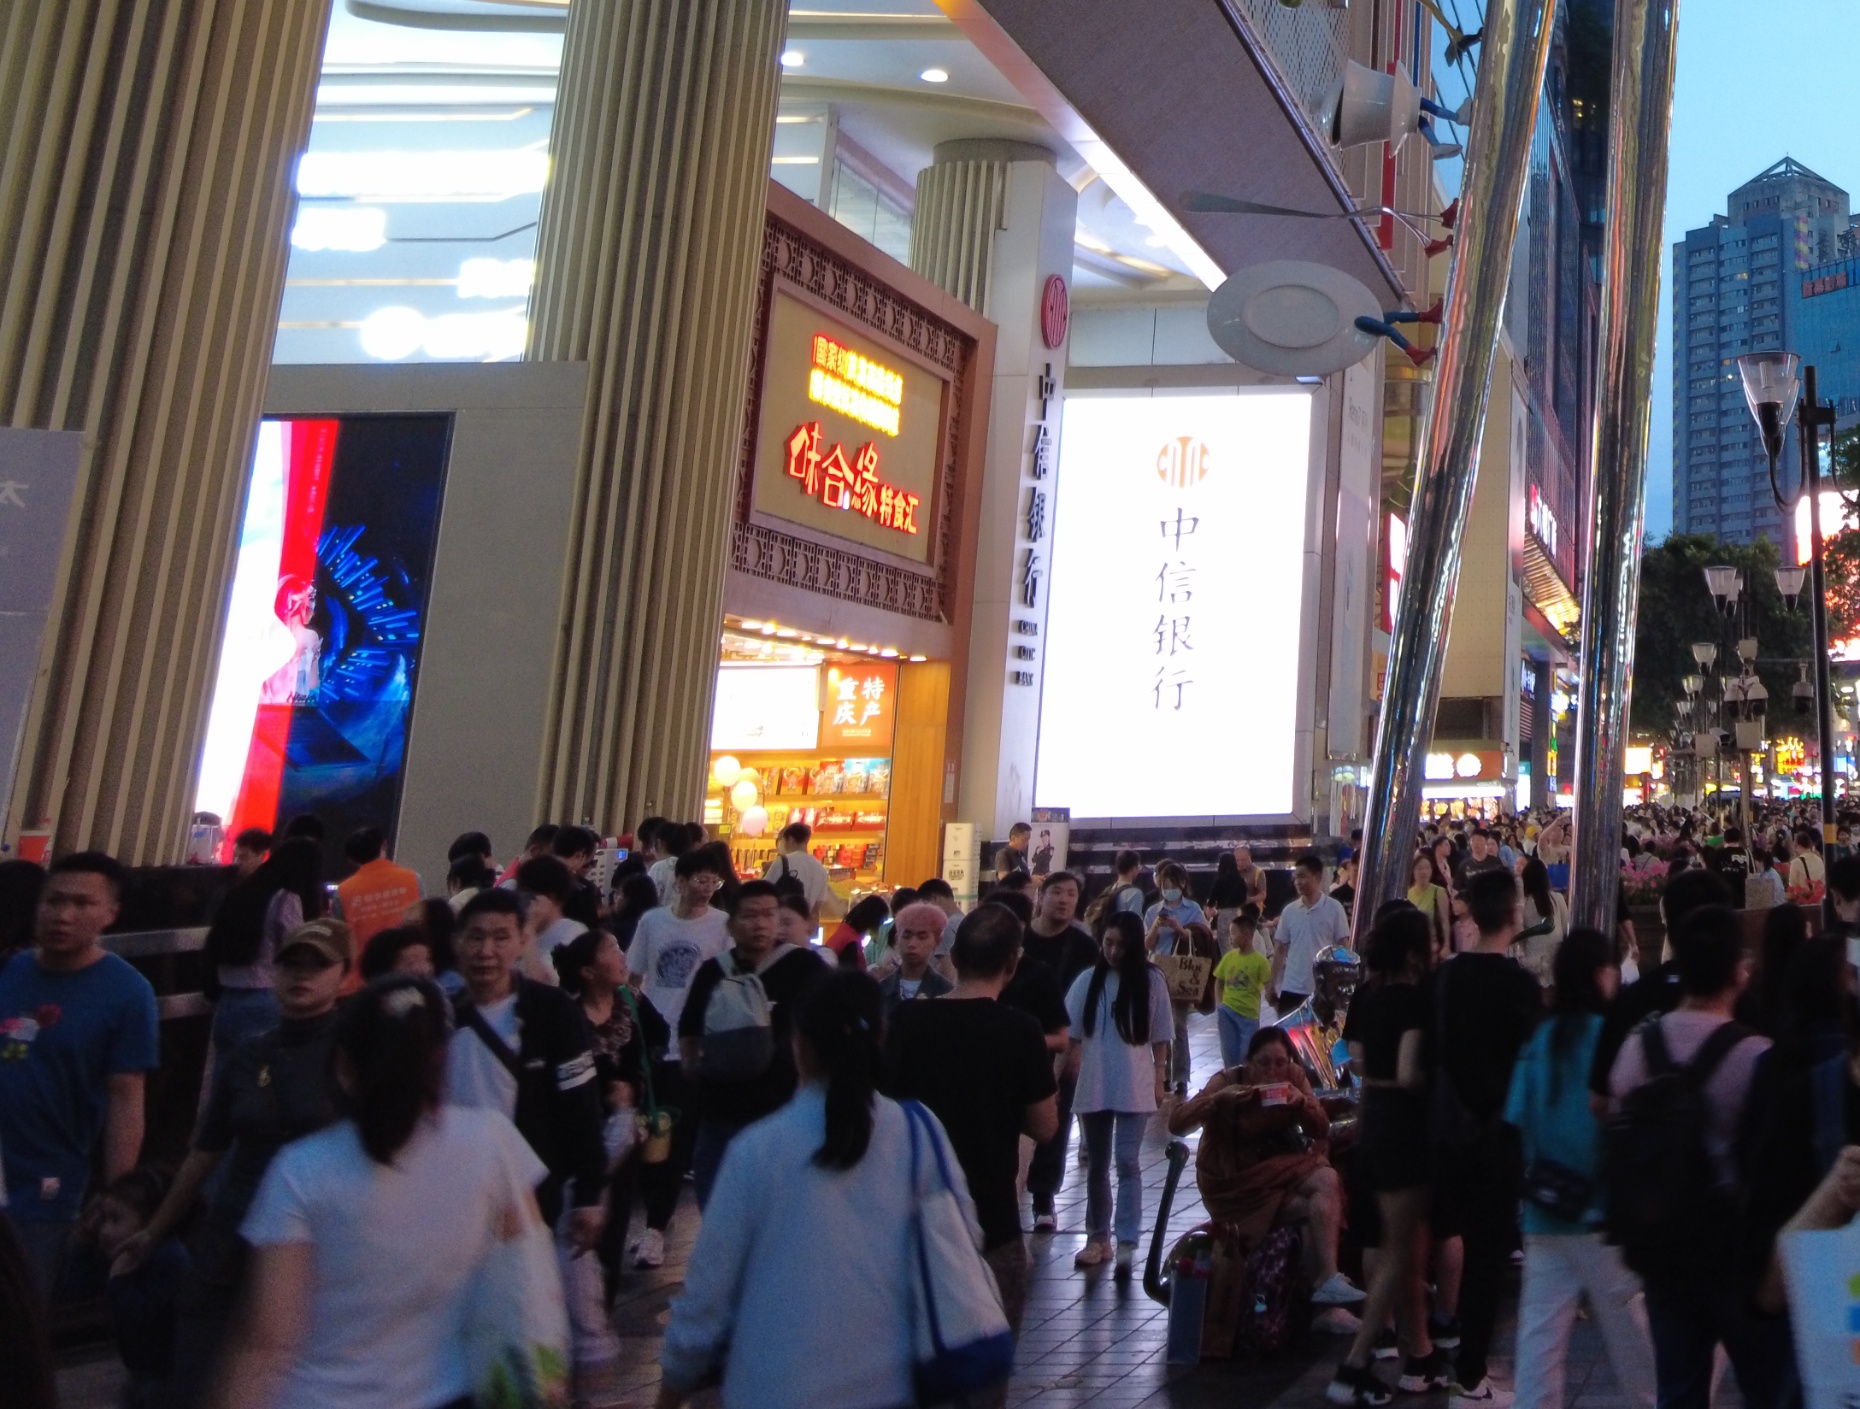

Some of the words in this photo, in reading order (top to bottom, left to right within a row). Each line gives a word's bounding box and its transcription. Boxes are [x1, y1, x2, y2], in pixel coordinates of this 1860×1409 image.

[1023, 363, 1056, 608] 中信银行
[1151, 507, 1200, 711] 中信银行
